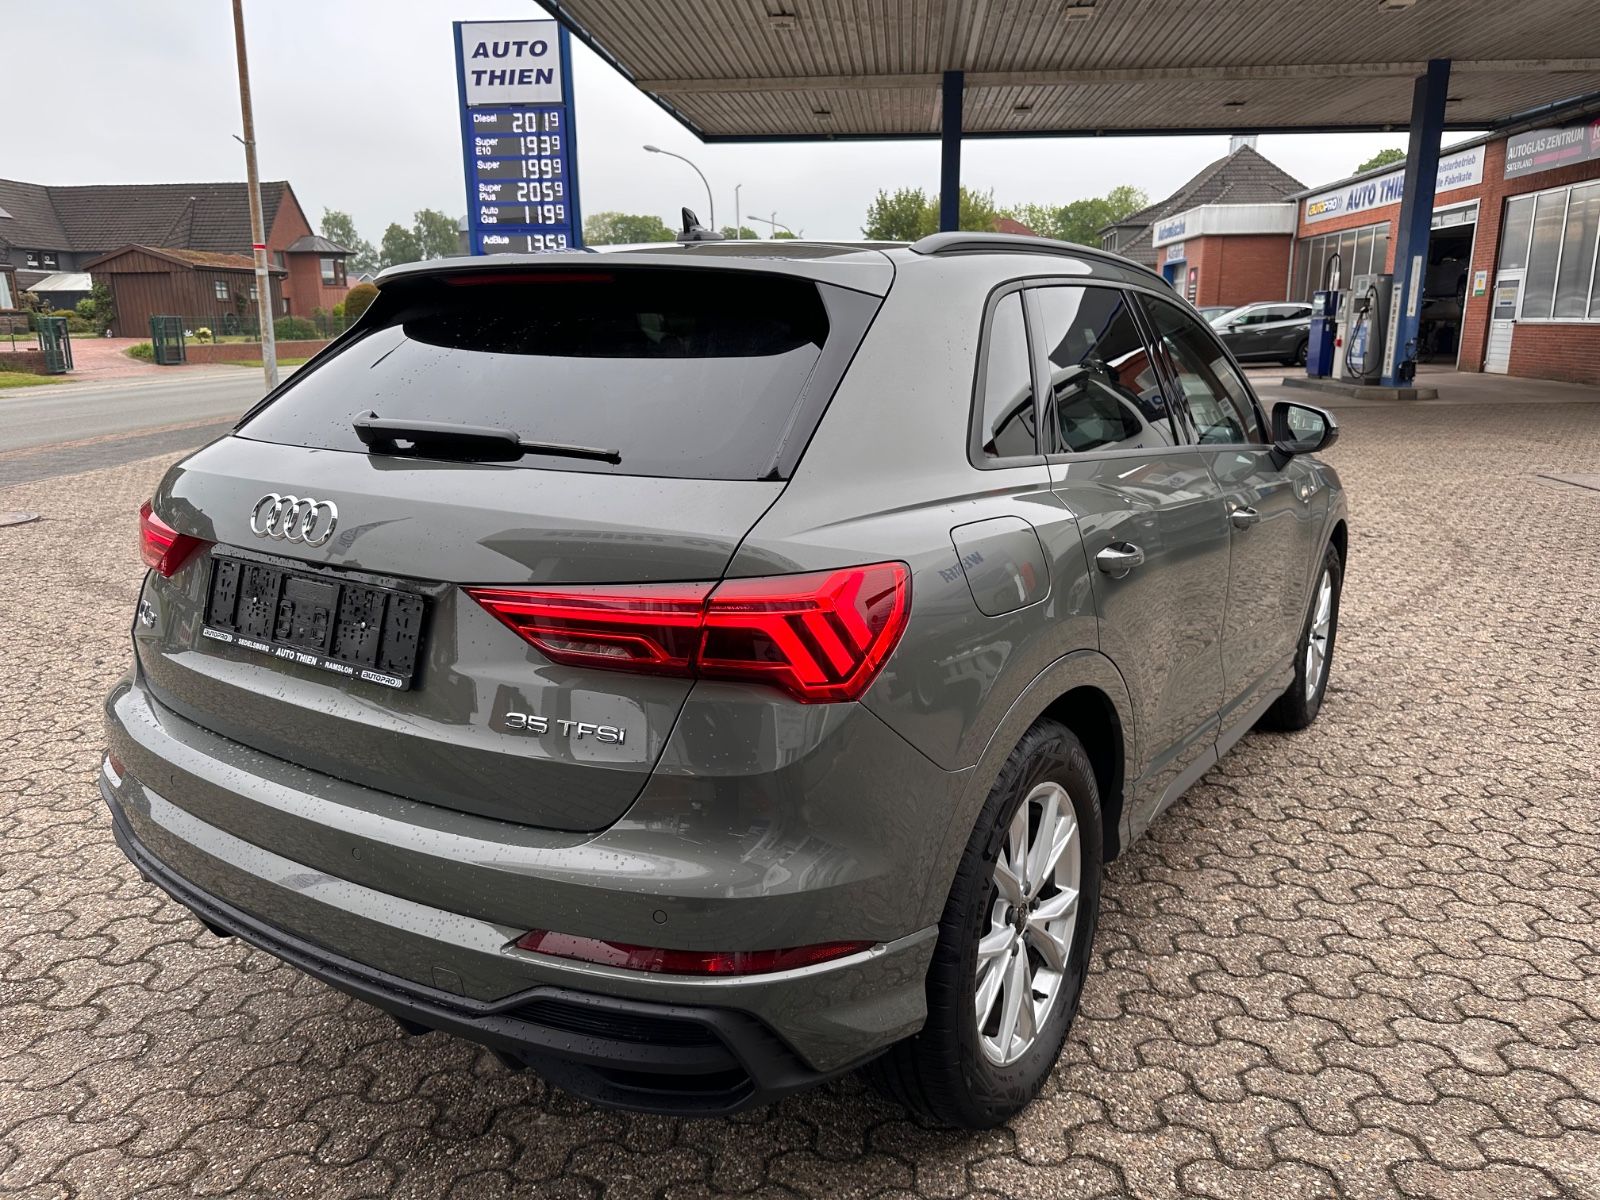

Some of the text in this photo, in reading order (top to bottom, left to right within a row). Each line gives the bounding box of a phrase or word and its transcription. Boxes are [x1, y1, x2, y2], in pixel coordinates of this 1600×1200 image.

[472, 40, 548, 59] AUTO
[471, 68, 554, 86] THIEN
[473, 113, 497, 123] Diesel
[475, 137, 498, 147] Super
[1507, 139, 1545, 160] AUTOGLAS
[1546, 127, 1585, 150] ZENTRUM
[475, 147, 491, 155] E10
[477, 160, 500, 170] Super
[1437, 153, 1476, 174] eisterbetrieb
[1444, 171, 1472, 186] Fabrikate
[478, 183, 501, 193] Super
[479, 192, 496, 201] Plus
[1346, 183, 1376, 211] AUTO
[480, 206, 499, 214] Auto
[481, 215, 498, 224] Gas
[483, 235, 509, 244] AdBlue
[275, 648, 295, 660] AUTO
[296, 652, 318, 666] THIEN
[324, 661, 354, 675] RAMSLOH
[505, 712, 626, 746] 35 TFSI
